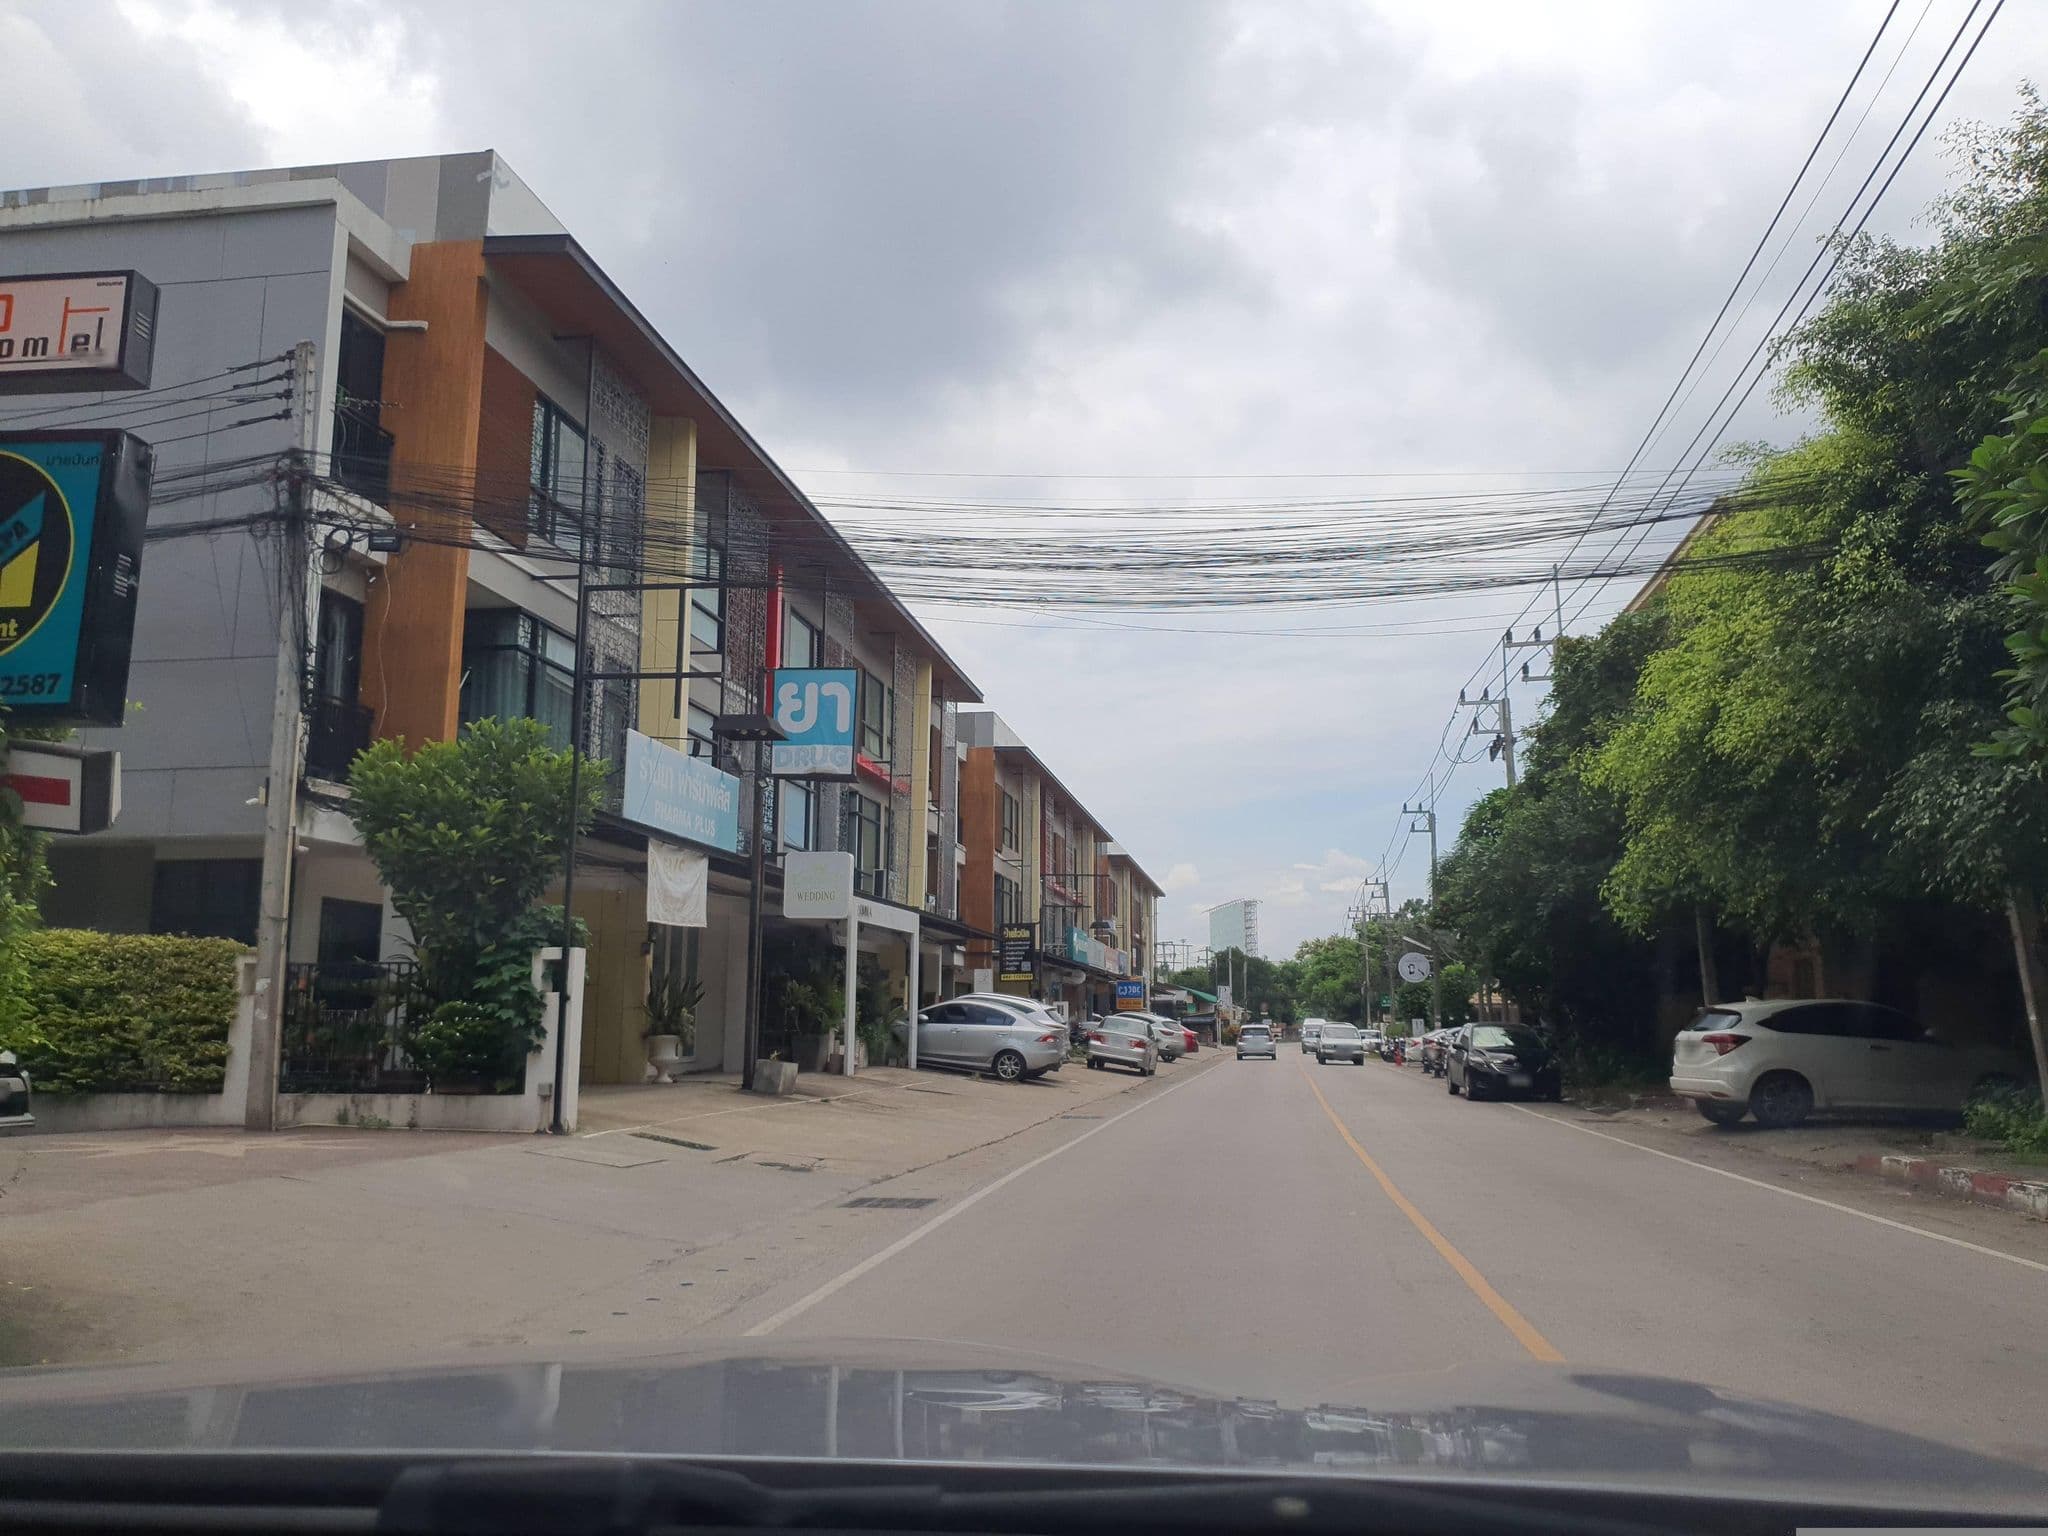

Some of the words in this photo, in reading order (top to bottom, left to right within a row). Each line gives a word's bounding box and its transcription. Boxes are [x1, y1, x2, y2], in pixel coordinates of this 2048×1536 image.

[777, 681, 851, 733] ยา
[774, 746, 848, 768] DRUG
[654, 799, 691, 831] PHARMA
[695, 815, 716, 838] PLUS
[797, 890, 836, 901] WEDDING
